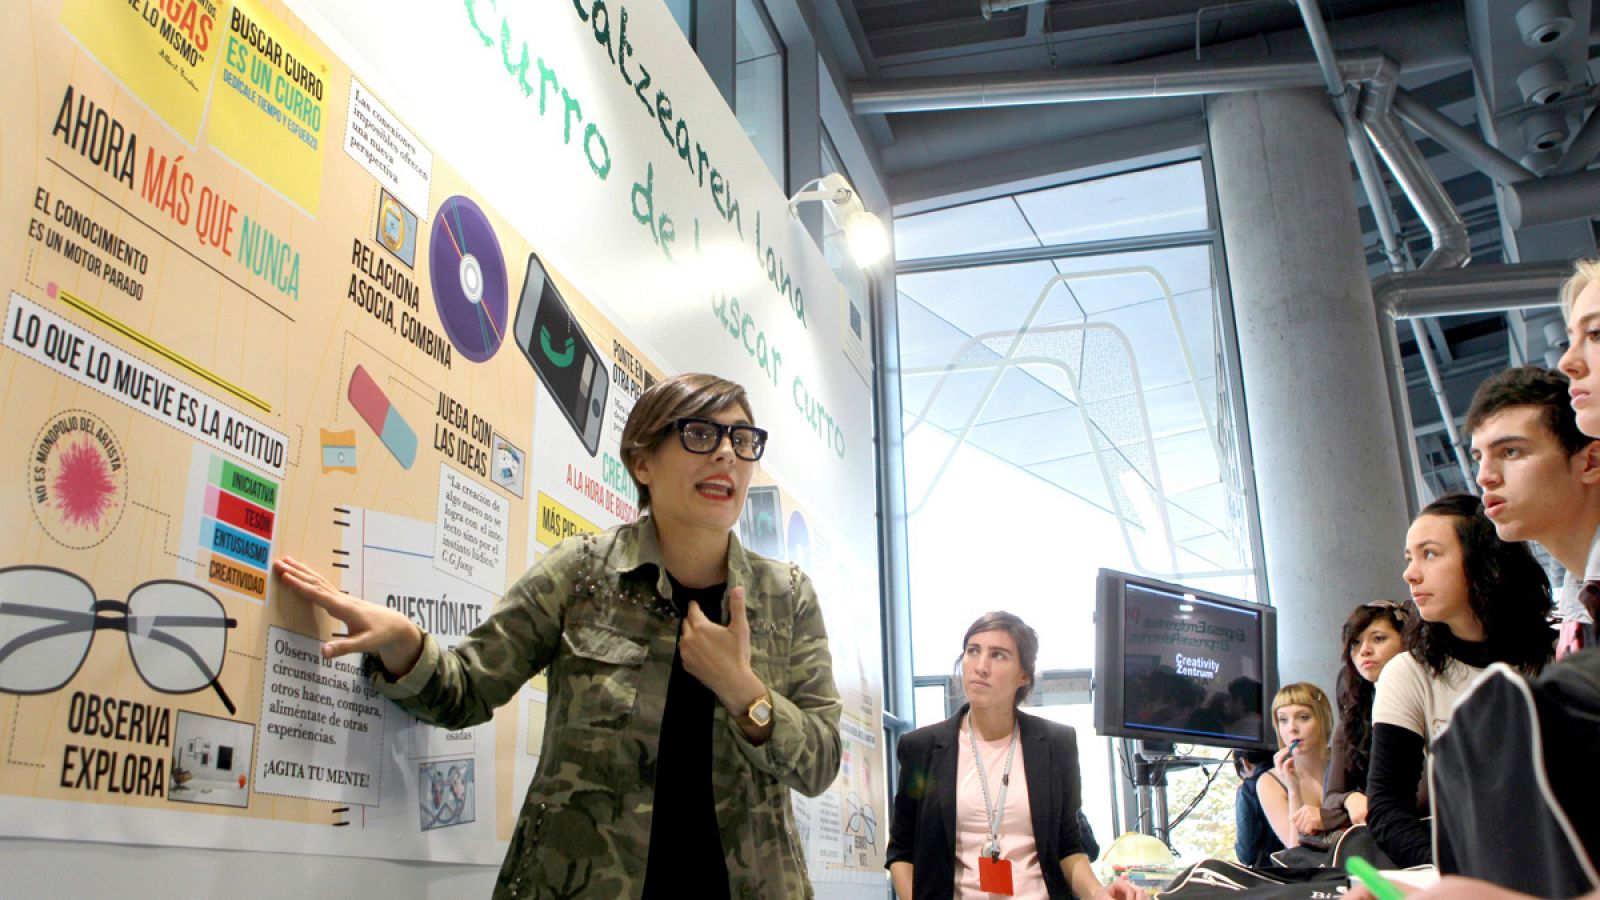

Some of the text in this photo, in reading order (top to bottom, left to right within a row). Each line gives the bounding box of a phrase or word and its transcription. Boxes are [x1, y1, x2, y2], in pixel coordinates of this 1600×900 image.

[142, 0, 160, 28] LO
[160, 0, 213, 52] GAS
[231, 6, 324, 102] BUSCAR CURRO
[226, 35, 321, 133] ES UN CURRO
[352, 121, 394, 165] una nueva
[353, 103, 428, 181] imposibles ofrecen
[355, 88, 417, 155] Las conexiones
[350, 135, 398, 184] perspectiva
[52, 84, 301, 301] AHORA MÁS QUE NUNCA
[33, 186, 149, 276] EL CONOCIMIENTO
[28, 218, 144, 301] ES UN MOTOR PARADO
[351, 237, 420, 313] RELACIONA
[755, 209, 808, 331] lana
[347, 273, 452, 371] ASOCIA, COMBINA
[631, 161, 676, 263] de
[792, 375, 846, 460] curro
[612, 339, 644, 383] PONTE EN
[612, 363, 630, 394] OTRA
[12, 307, 285, 470] LO QUE LO MUEVE ES LA ACTITUD
[436, 391, 493, 449] JUEGA CON
[34, 416, 122, 504] NO ES MONOPOLIO DEL ARTISTA
[434, 423, 488, 478] LAS IDEAS
[231, 471, 276, 505] INICIATIVA
[462, 484, 491, 507] creación
[492, 499, 501, 513] de
[566, 464, 573, 486] A
[573, 467, 582, 494] LA
[584, 474, 604, 507] HORA
[605, 489, 614, 514] DE
[602, 452, 640, 503] CREATI
[244, 506, 271, 533] TESÓN
[444, 503, 464, 523] logra
[464, 518, 478, 530] con
[479, 523, 488, 535] el
[445, 490, 502, 528] algo nuevo no se
[541, 506, 561, 536] MÁS
[213, 528, 269, 565] ENTUSIASMO
[442, 533, 471, 557] instinto
[443, 518, 500, 555] lecto sino por el
[208, 559, 265, 595] CREATIVIDAD
[272, 659, 350, 694] circunstancias,
[351, 679, 361, 694] lo
[275, 639, 370, 679] Observa tu entorn
[1175, 653, 1220, 674] Creativity
[1175, 664, 1215, 680] Zentrum
[67, 691, 171, 748] OBSERVA
[269, 699, 369, 733] aliméntate de otras
[271, 682, 382, 720] otros hacen, compara,
[267, 722, 337, 745] experiencias.
[60, 744, 165, 798] EXPLORA
[263, 759, 371, 789] ¡AGITA TU MENTE!
